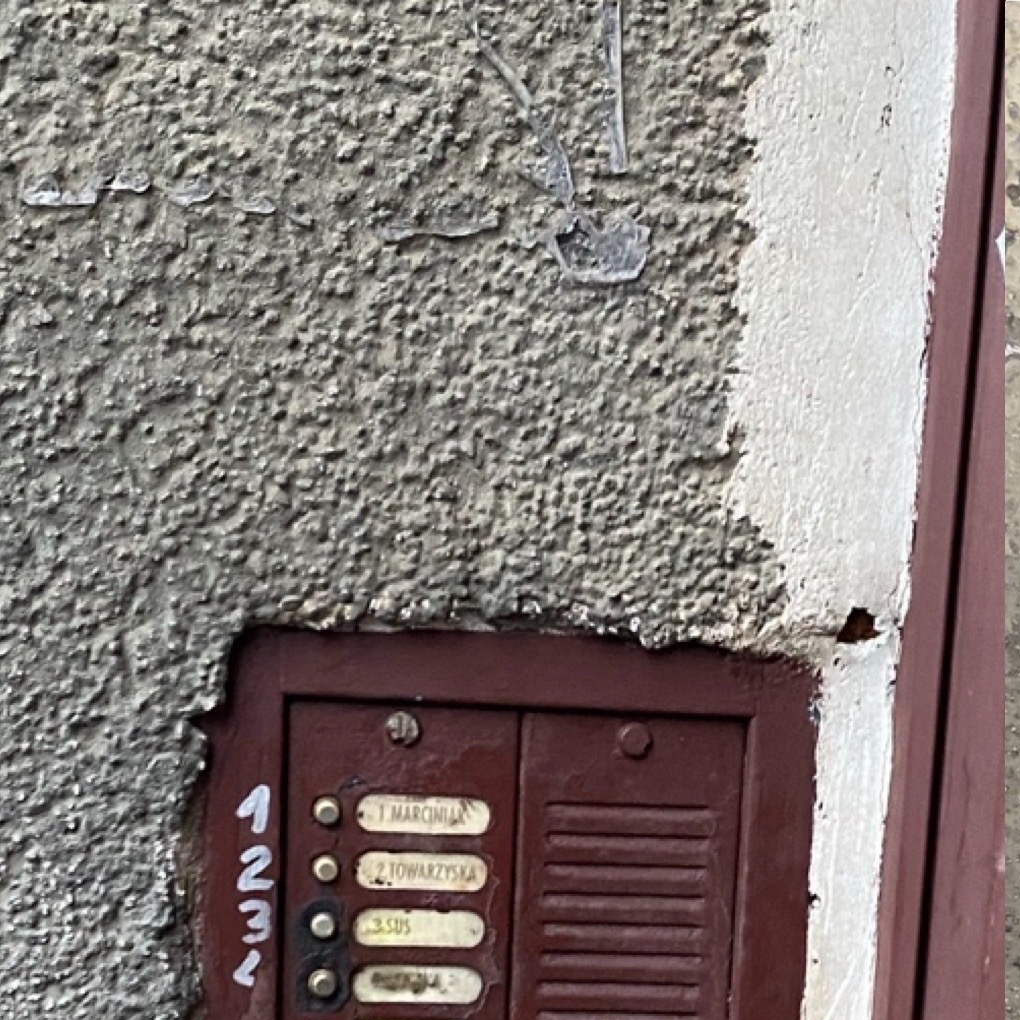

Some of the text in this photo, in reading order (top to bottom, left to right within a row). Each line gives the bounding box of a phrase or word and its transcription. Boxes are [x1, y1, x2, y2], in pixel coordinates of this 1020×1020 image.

[236, 784, 271, 834] 1
[237, 845, 275, 893] 2
[238, 899, 272, 943] 3
